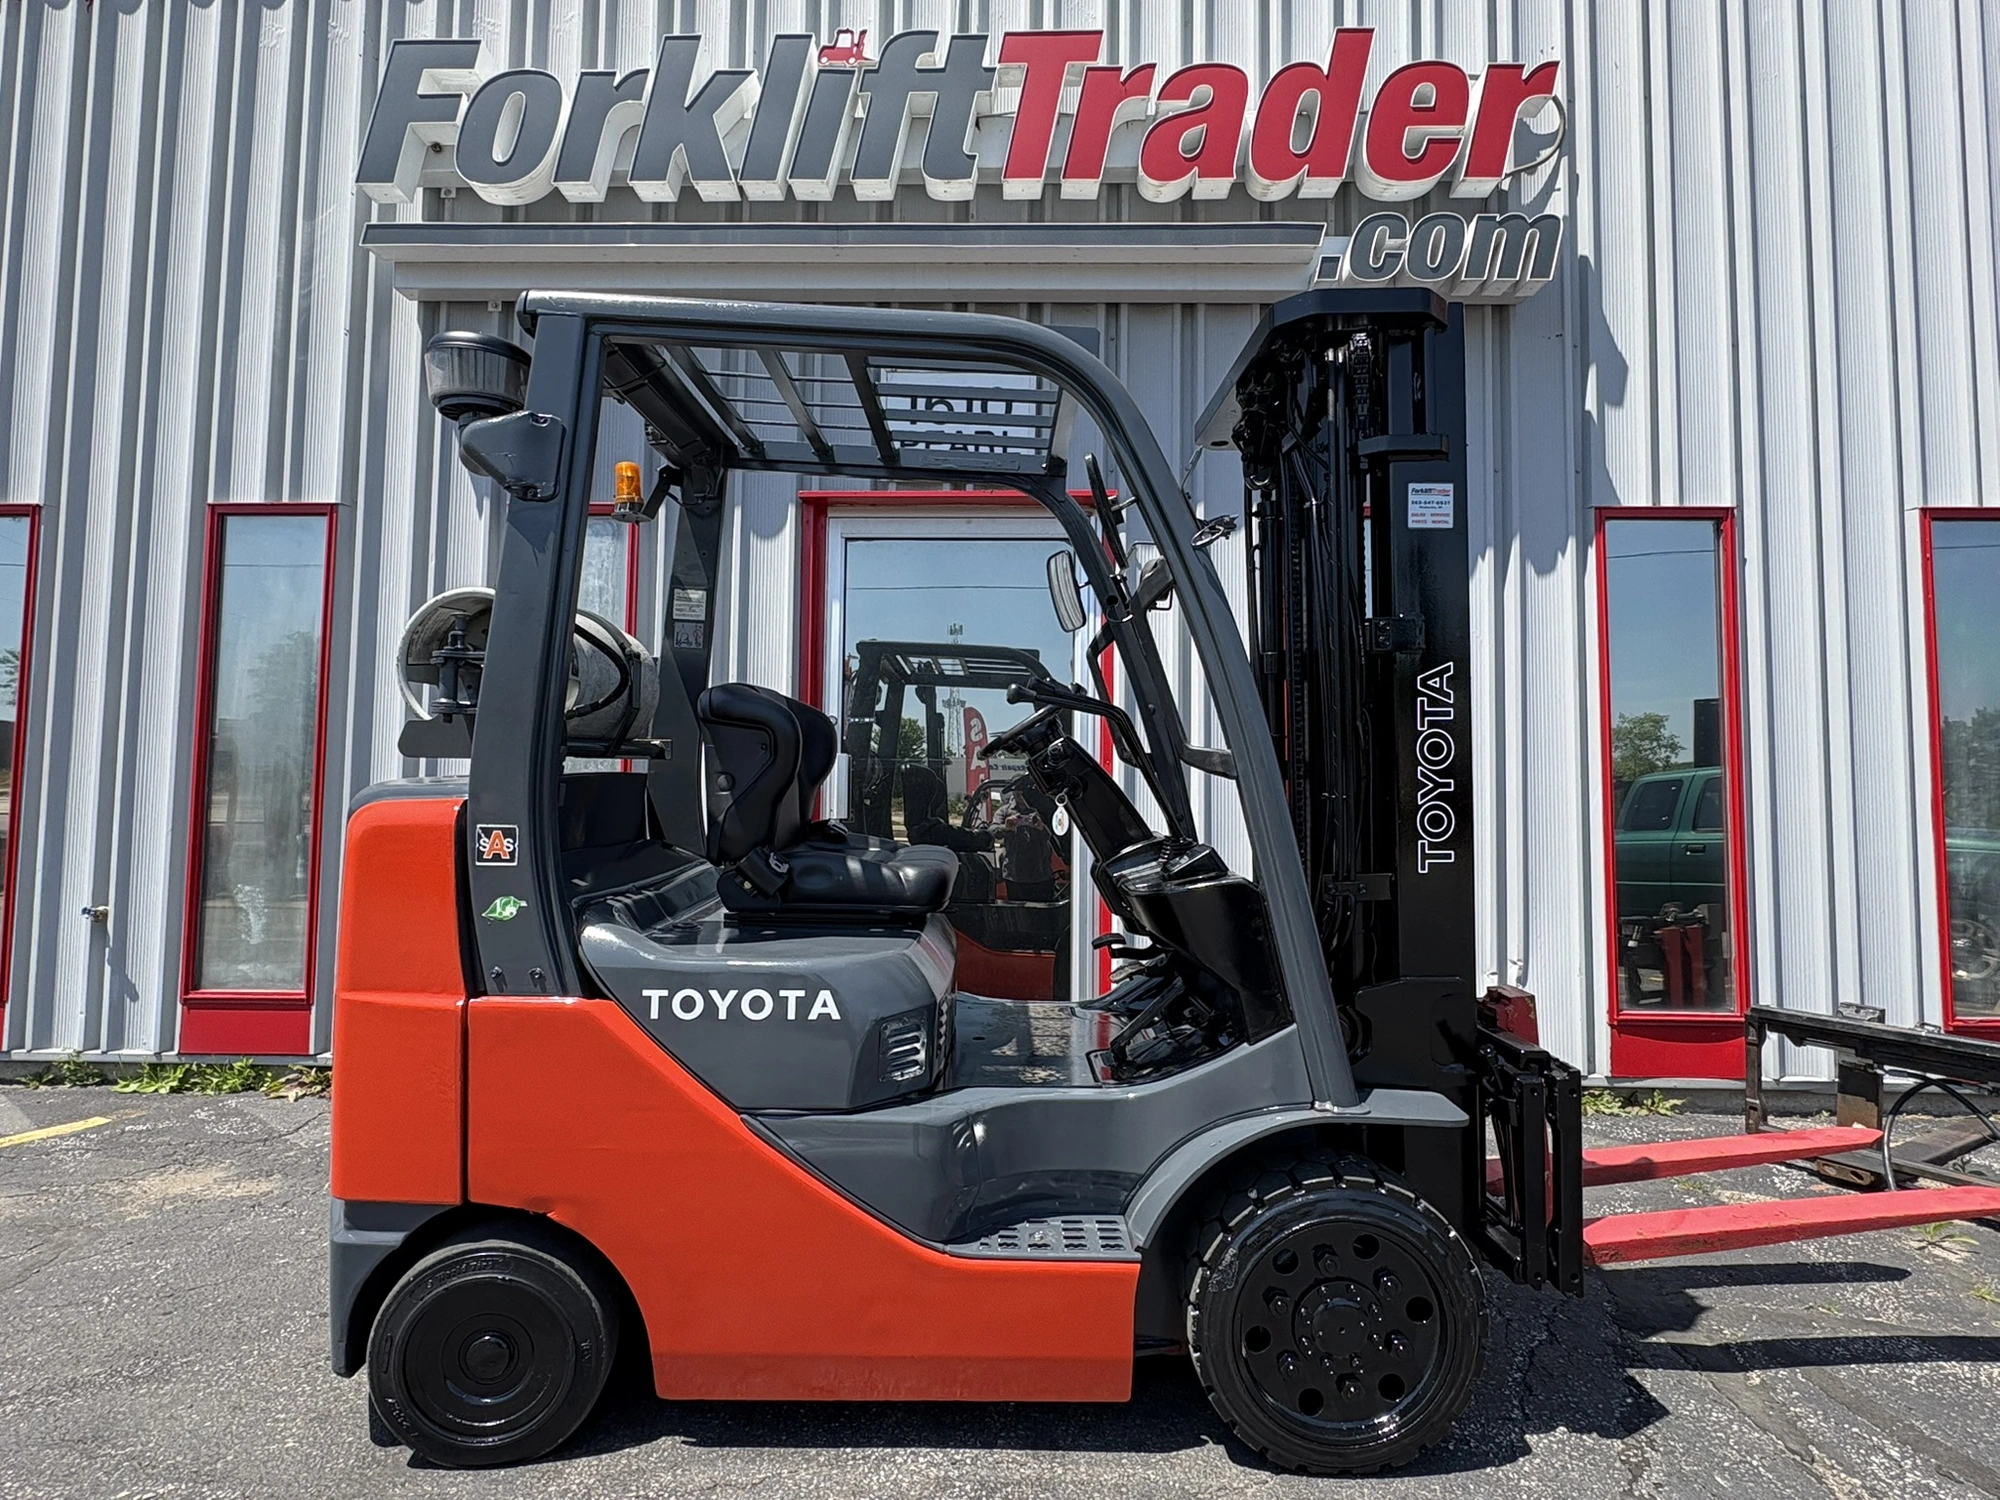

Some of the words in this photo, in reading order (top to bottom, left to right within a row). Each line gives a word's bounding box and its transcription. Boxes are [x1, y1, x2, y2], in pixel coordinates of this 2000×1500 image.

[357, 27, 1560, 203] ForkliftTrader
[1316, 212, 1563, 282] .com
[1416, 661, 1455, 874] TOYOTA
[641, 988, 841, 1021] TOYOTA
